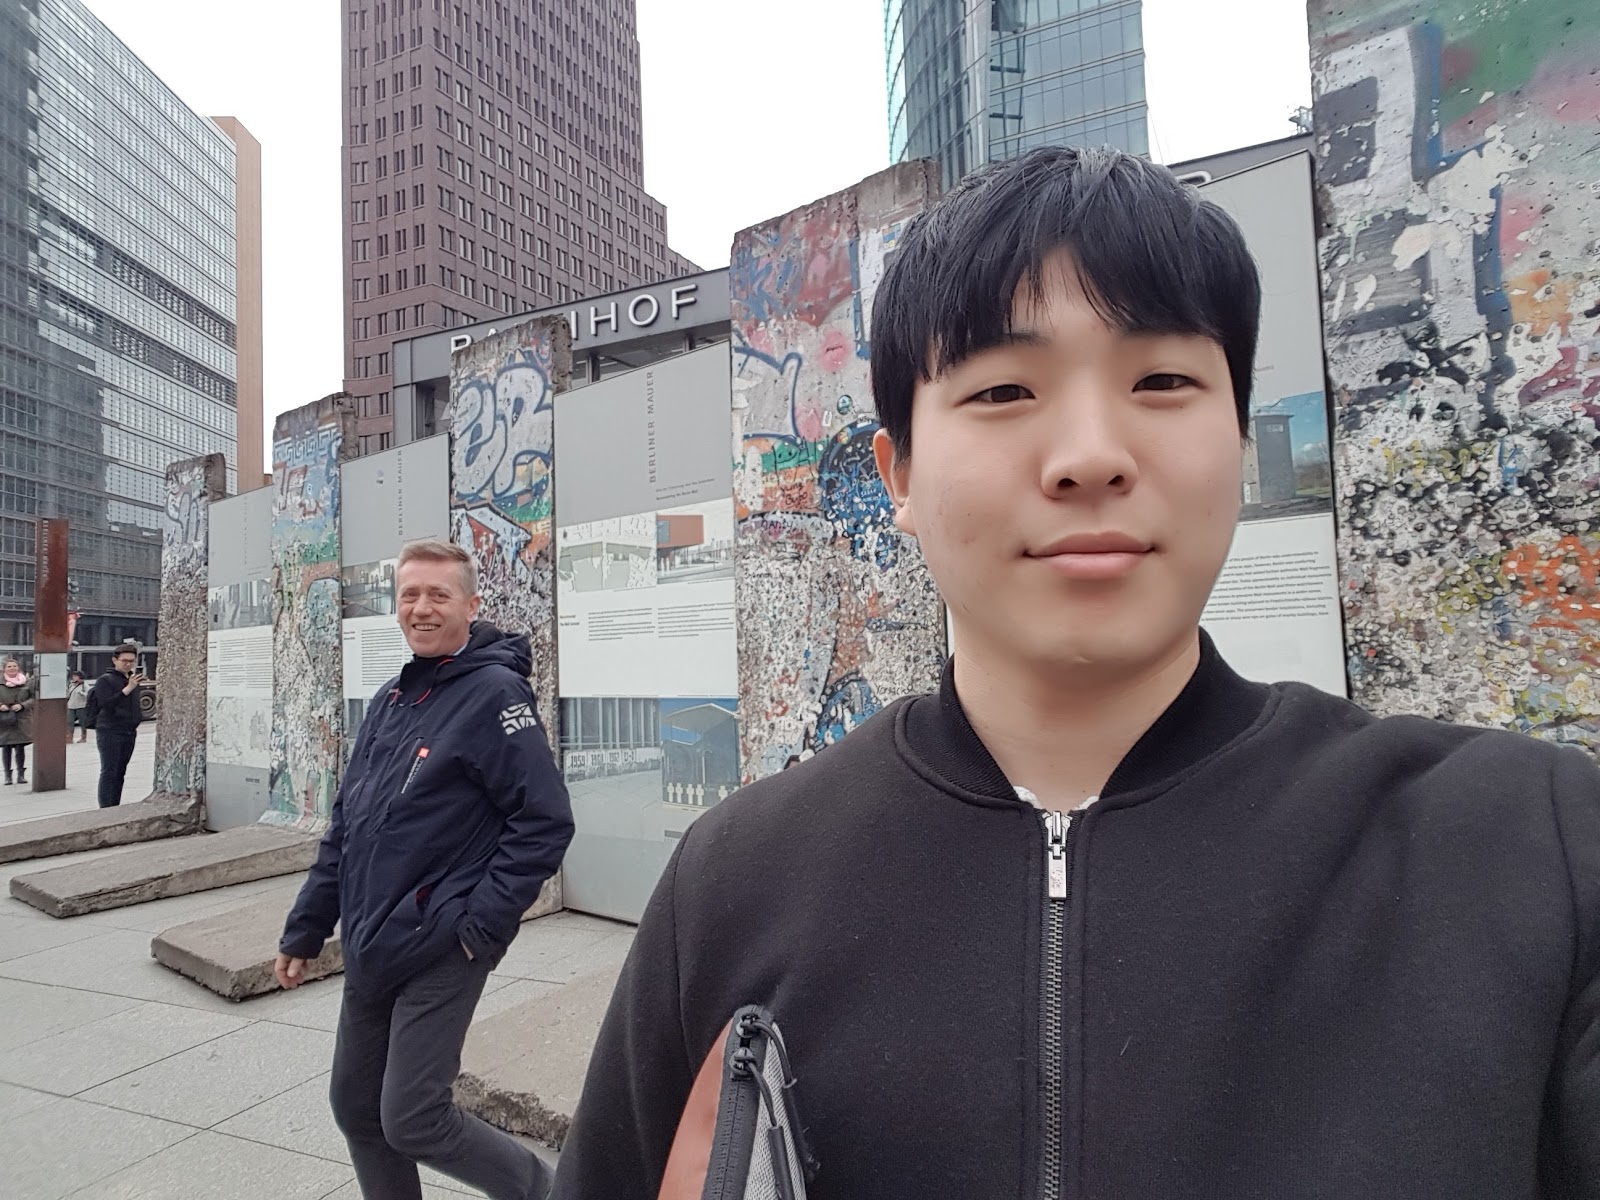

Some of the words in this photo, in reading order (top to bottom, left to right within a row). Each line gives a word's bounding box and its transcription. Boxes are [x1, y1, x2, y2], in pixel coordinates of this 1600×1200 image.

[450, 283, 698, 354] BHOF
[646, 370, 655, 415] MAUER
[648, 421, 657, 484] BERLINER
